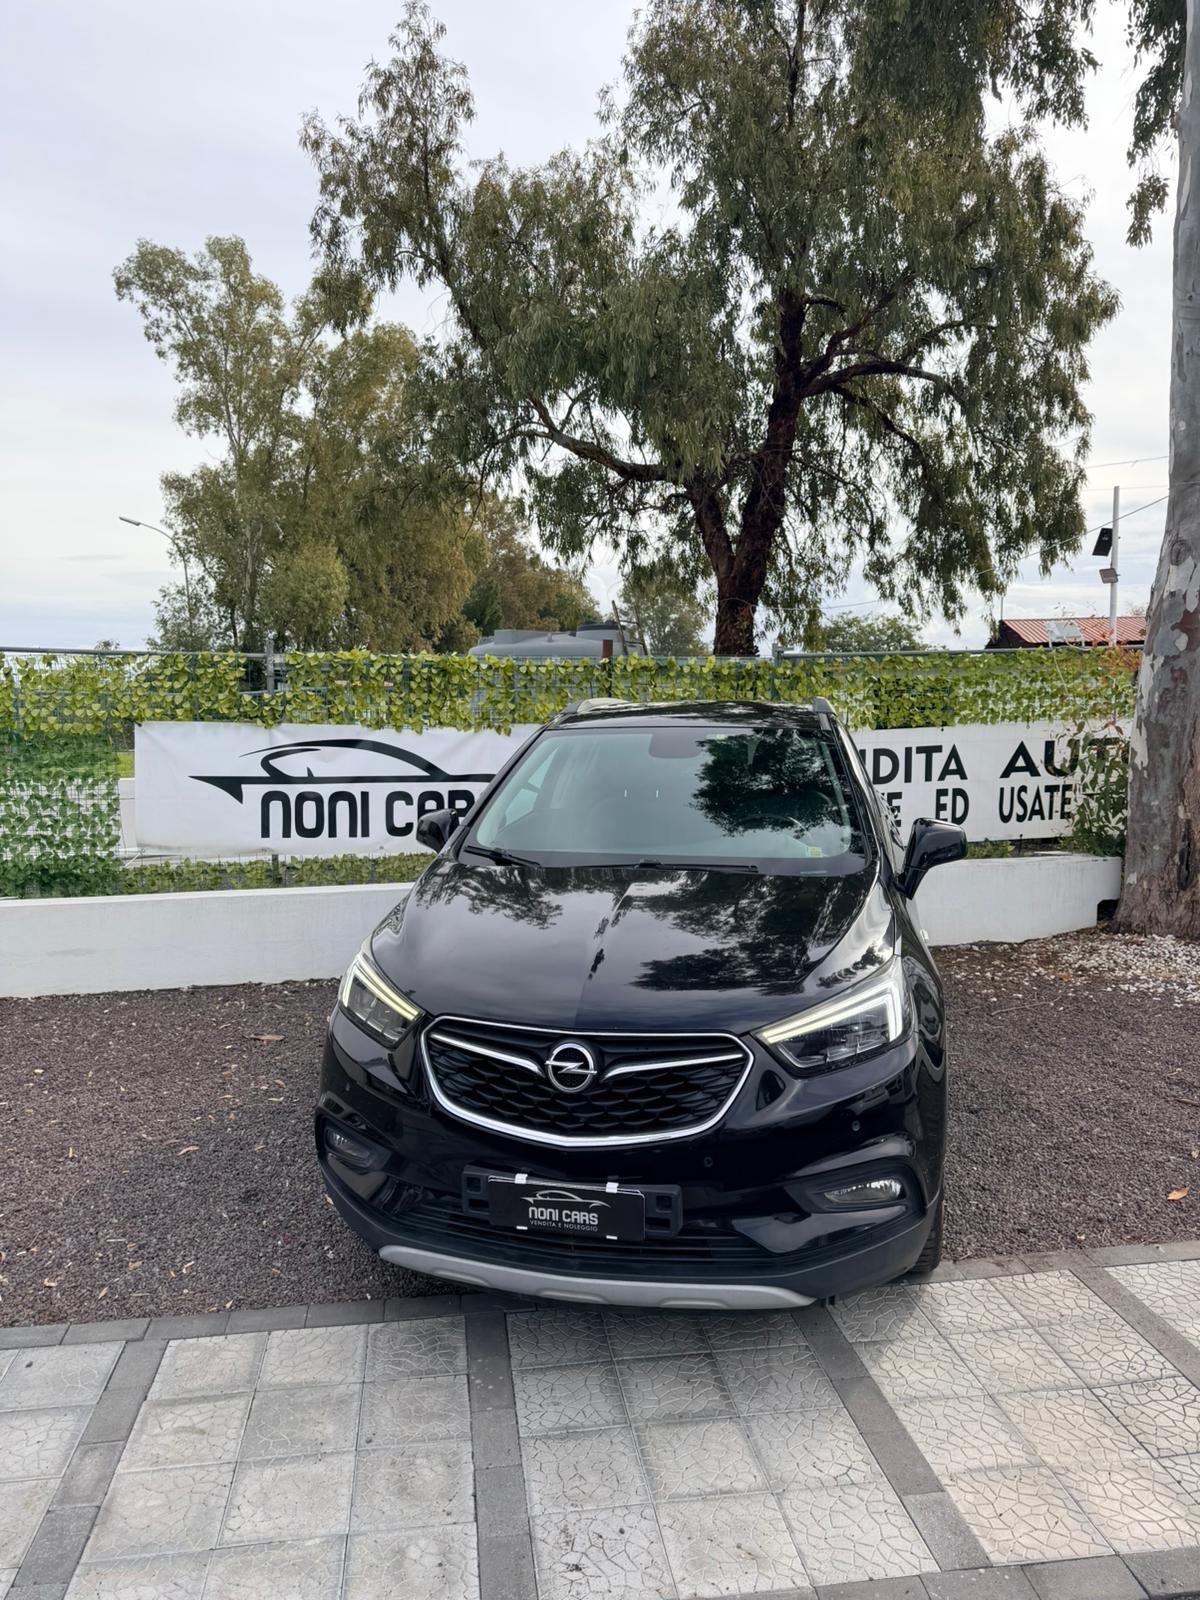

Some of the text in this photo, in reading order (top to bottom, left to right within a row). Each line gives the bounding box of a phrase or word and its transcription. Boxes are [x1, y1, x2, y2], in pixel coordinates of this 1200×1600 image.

[999, 737, 1130, 779] AUT
[260, 790, 370, 839] NONI
[935, 787, 970, 826] ED
[998, 784, 1074, 824] USATE
[528, 1206, 599, 1226] NONI CARS
[529, 1219, 557, 1228] VENDITA
[563, 1223, 599, 1233] NOLEGGIO
